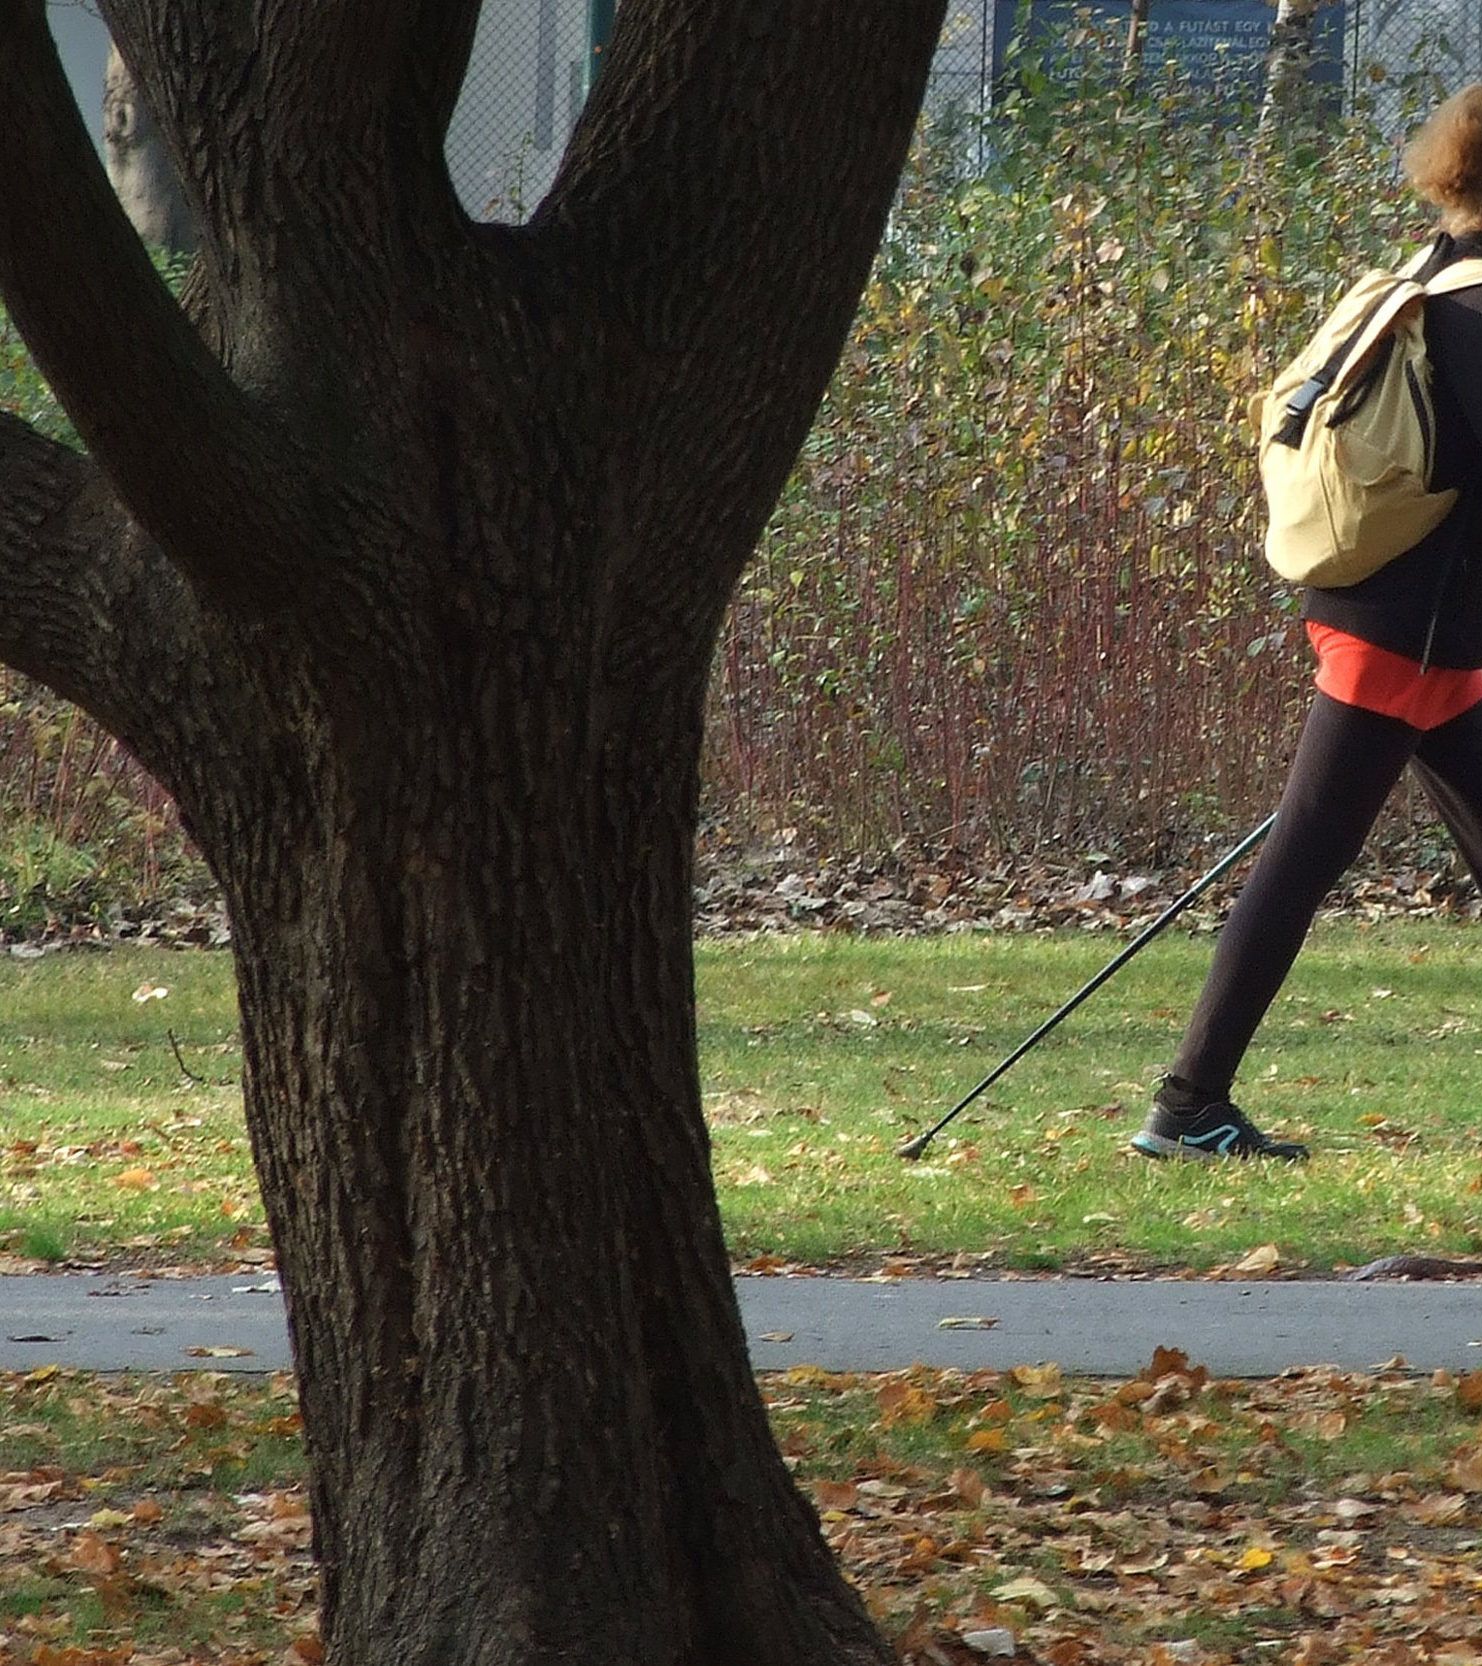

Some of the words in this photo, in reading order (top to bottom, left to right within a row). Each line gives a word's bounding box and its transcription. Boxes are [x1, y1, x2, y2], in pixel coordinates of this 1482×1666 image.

[1164, 21, 1174, 32] A
[1179, 18, 1229, 33] FUTÁST
[1234, 20, 1261, 33] EGY
